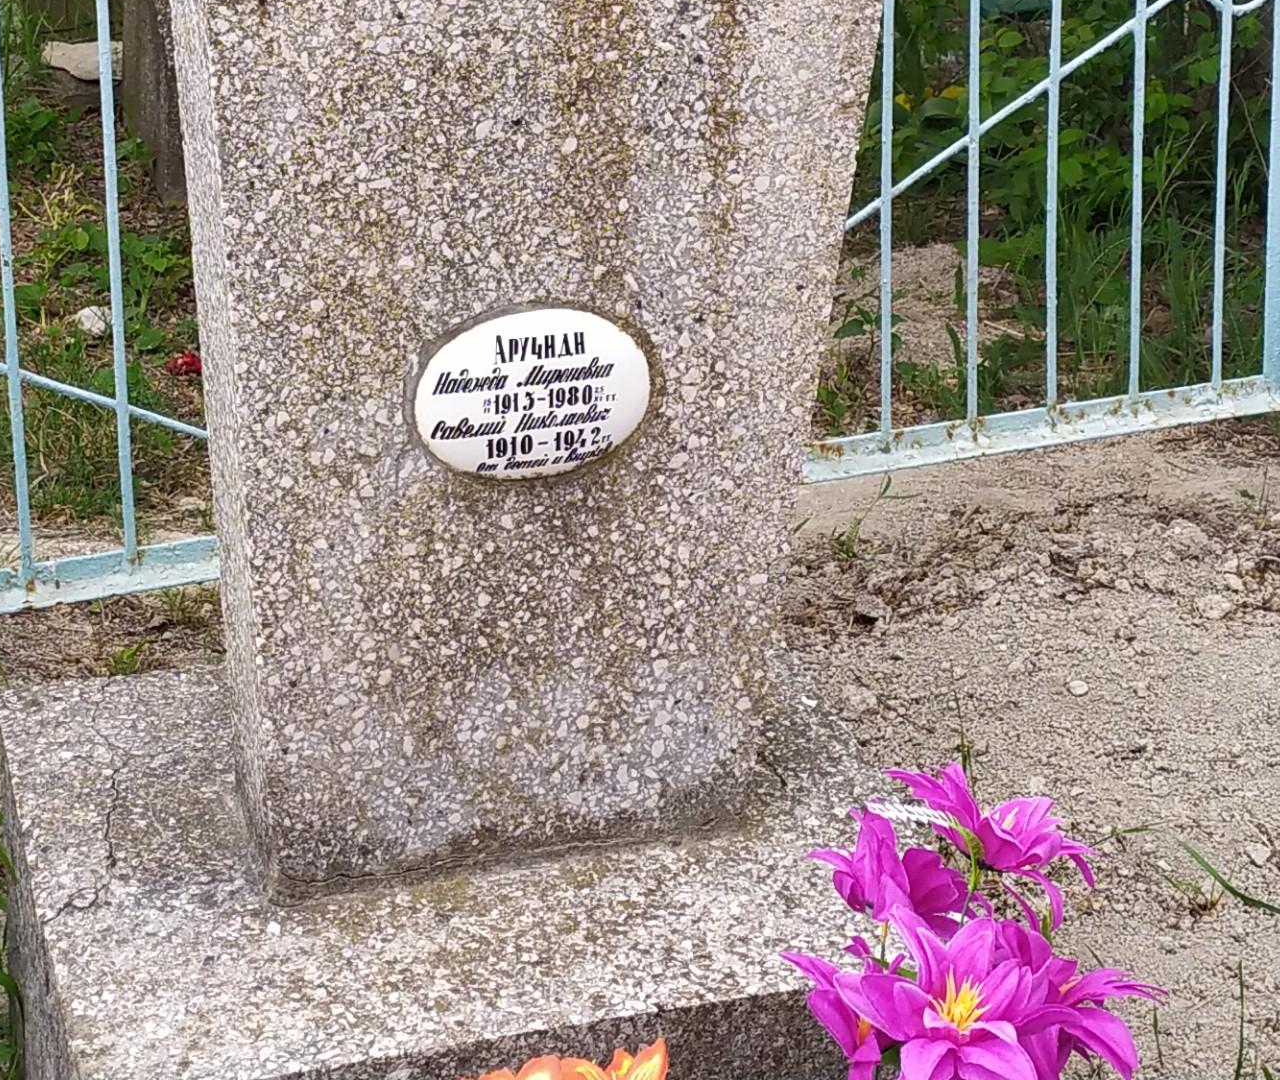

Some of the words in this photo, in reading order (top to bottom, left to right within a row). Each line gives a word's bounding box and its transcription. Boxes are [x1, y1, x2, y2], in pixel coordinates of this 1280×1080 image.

[432, 367, 509, 396] Надежда
[431, 415, 507, 440] Савелий
[514, 403, 612, 433] Николаевич
